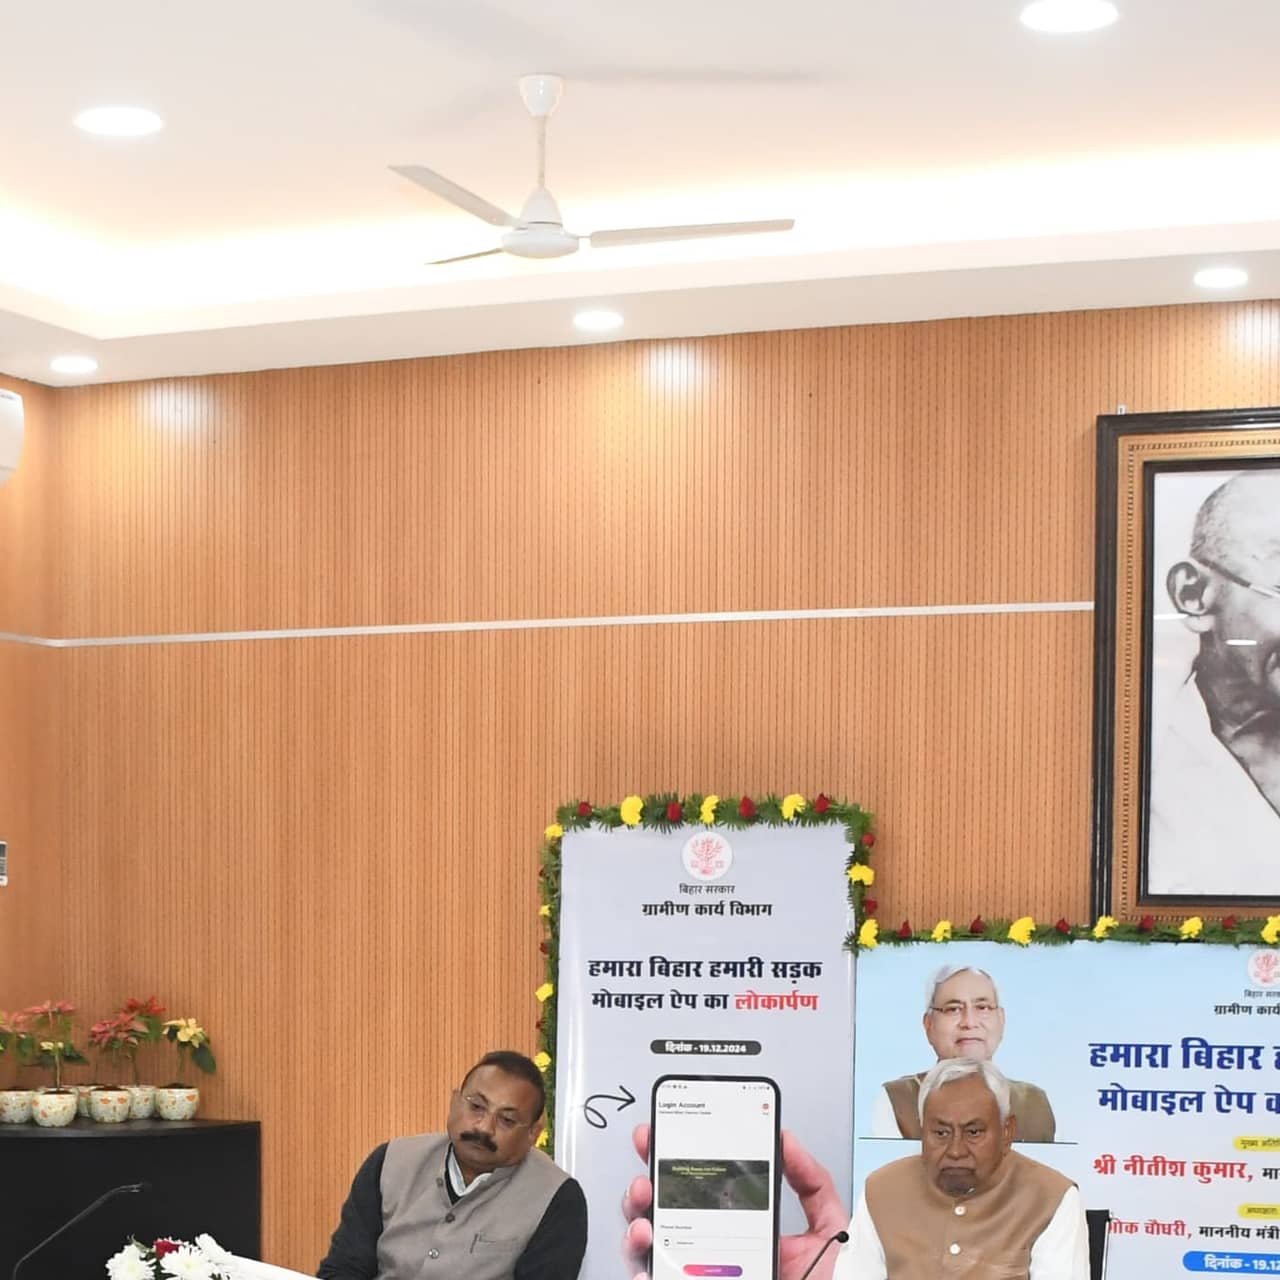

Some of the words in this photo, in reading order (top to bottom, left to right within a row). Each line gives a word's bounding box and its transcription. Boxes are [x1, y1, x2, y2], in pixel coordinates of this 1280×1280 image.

[679, 883, 703, 895] बिहार
[705, 884, 735, 895] सरकार
[642, 900, 690, 916] ग्रामीण
[694, 901, 724, 916] कार्य
[729, 900, 772, 916] विभाग
[588, 960, 643, 978] हमारा
[649, 956, 703, 978] बिहार
[708, 956, 764, 978] हमारी
[770, 961, 823, 984] सड़क
[592, 988, 664, 1010] मोबाइल
[670, 989, 698, 1009] ऐप
[704, 993, 729, 1009] का
[734, 989, 818, 1010] लोकार्पण
[1214, 1002, 1252, 1016] ग्रामीण
[1256, 1003, 1280, 1016] कार्य
[1088, 1042, 1172, 1069] हमारा
[1180, 1036, 1264, 1070] बिहार
[1097, 1082, 1206, 1115] मोबाइल
[1214, 1084, 1256, 1115] ऐप
[1093, 1153, 1117, 1177] श्री
[1123, 1154, 1187, 1178] नीतीश
[1192, 1159, 1254, 1184] कुमार,
[1144, 1218, 1193, 1239] चौधरी,
[1198, 1224, 1251, 1240] माननीय
[1203, 1253, 1244, 1270] दिनांक
